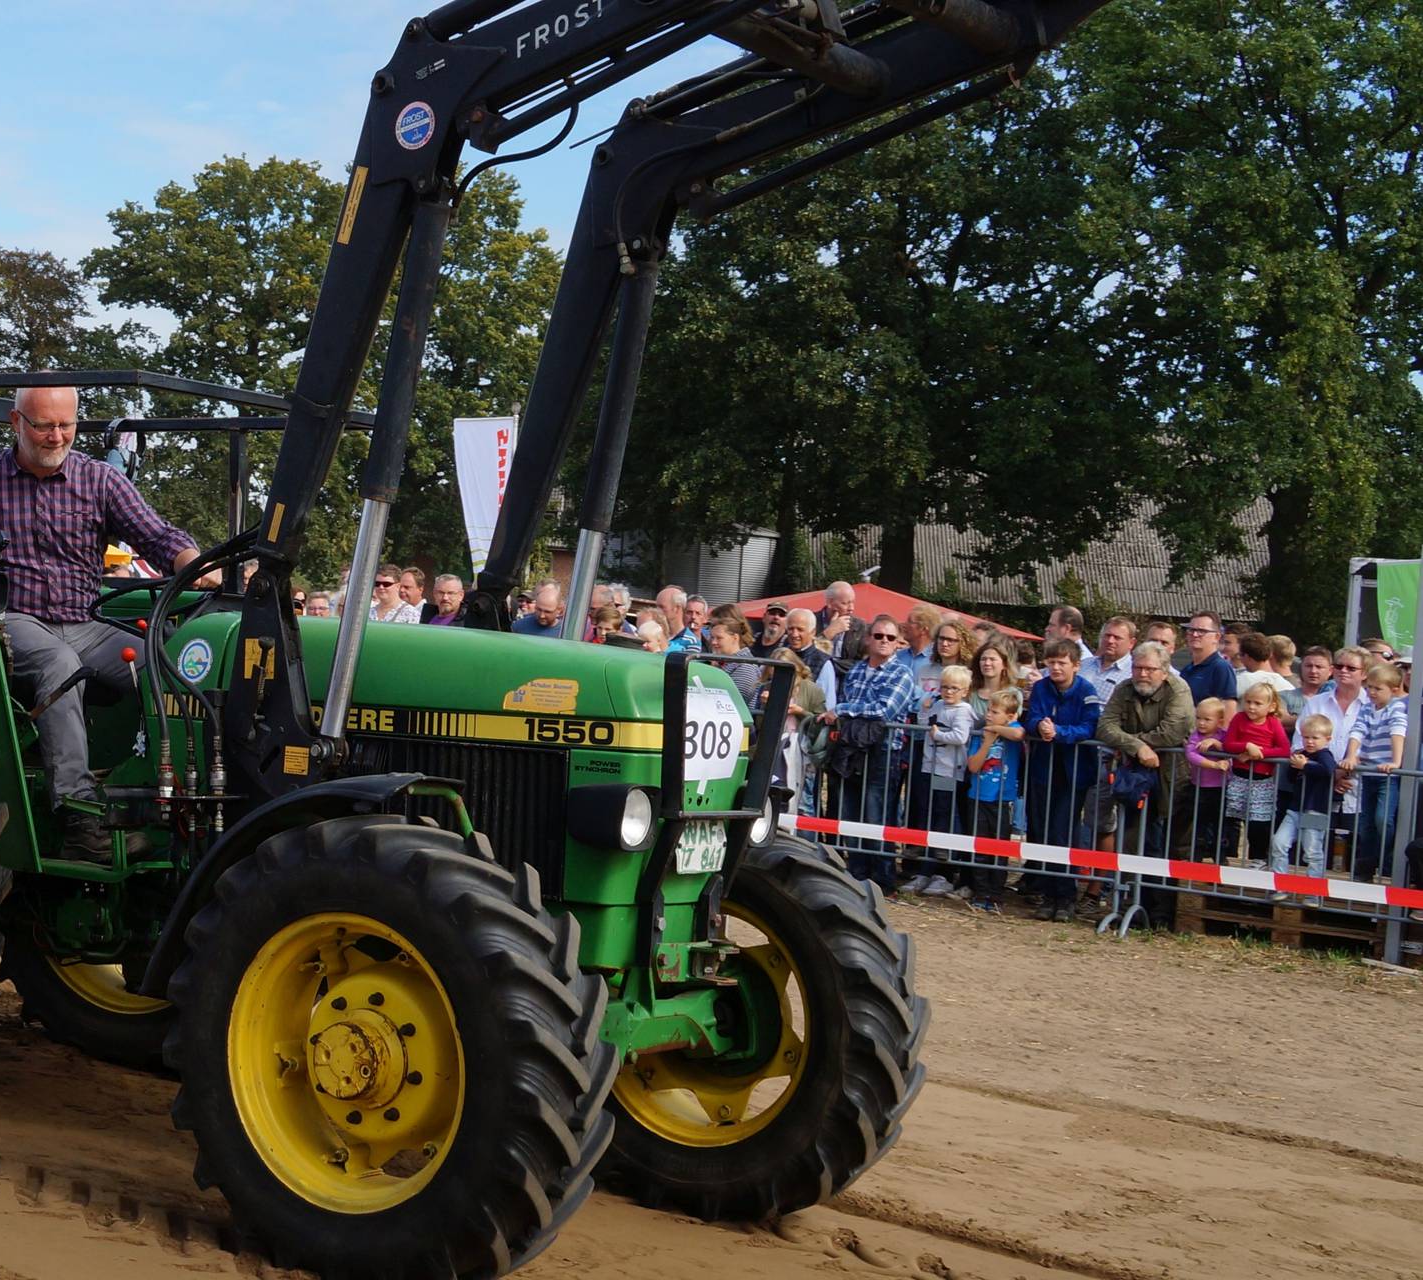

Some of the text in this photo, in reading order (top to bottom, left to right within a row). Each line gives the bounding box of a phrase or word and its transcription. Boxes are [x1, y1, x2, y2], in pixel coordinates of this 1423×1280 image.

[516, 0, 606, 58] FROST
[401, 110, 425, 127] FROST
[310, 706, 395, 732] DERE
[524, 718, 615, 745] 1550
[684, 720, 733, 760] 308
[589, 760, 621, 768] POWER
[684, 820, 718, 846] WAF
